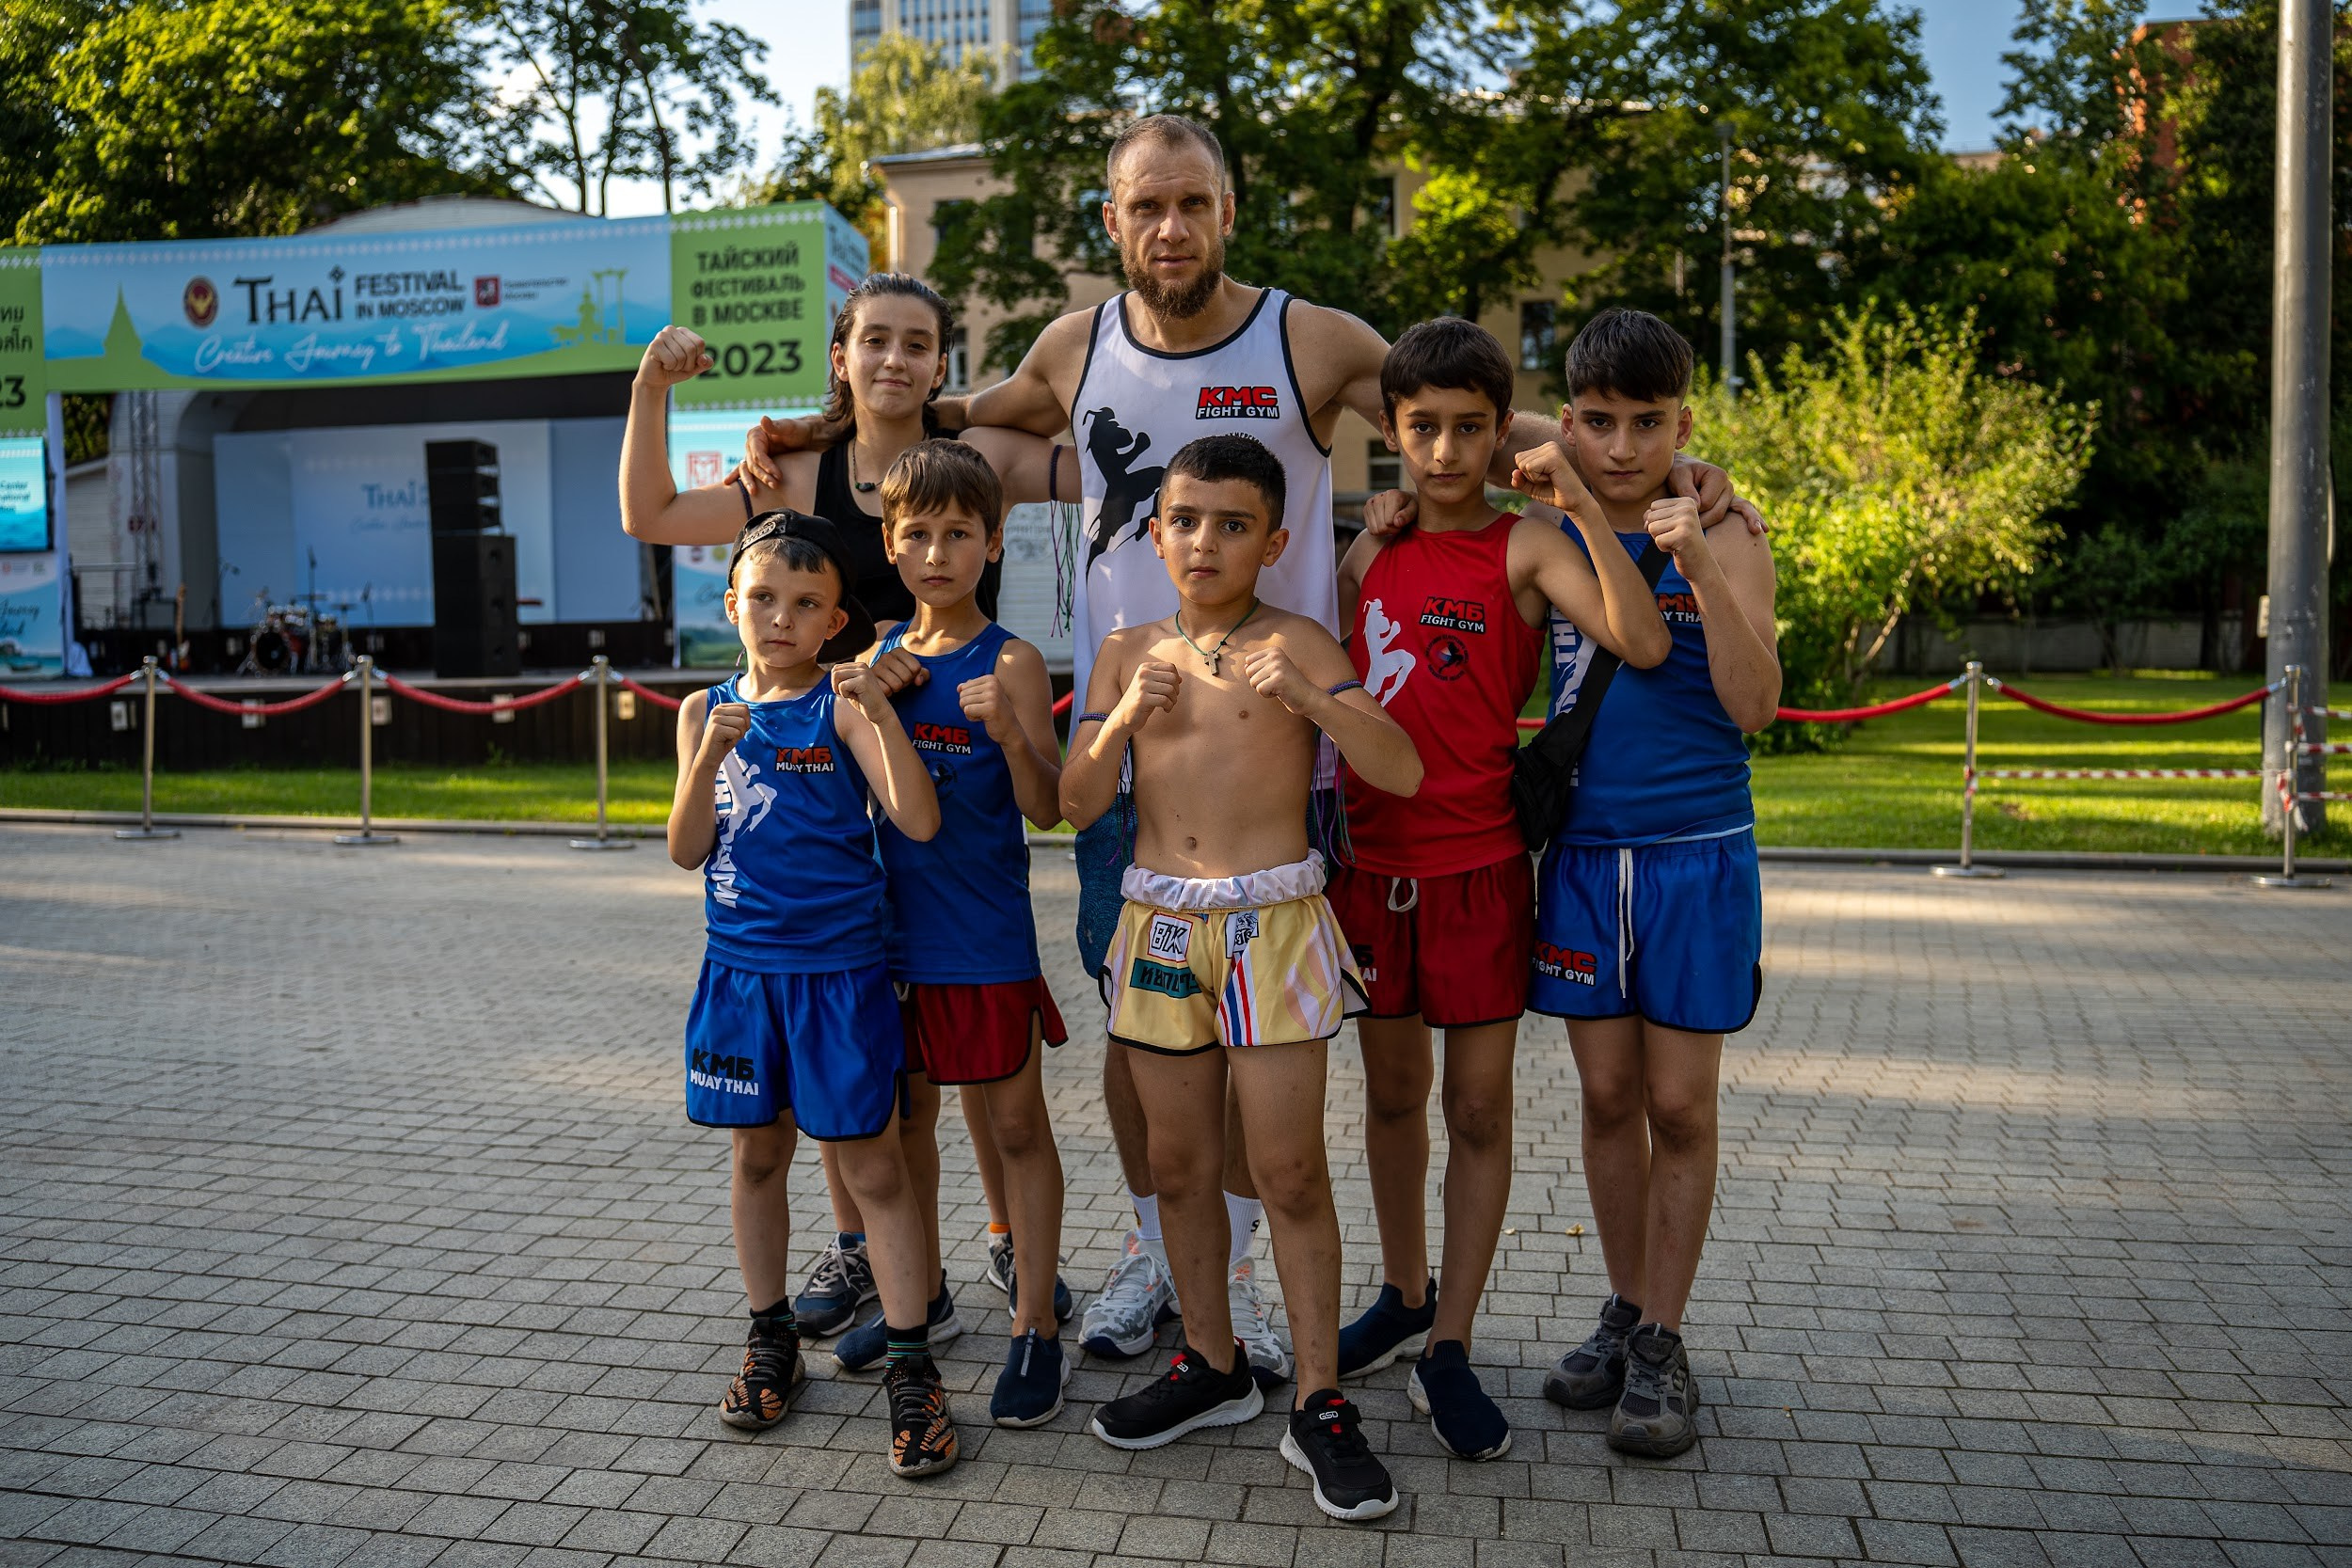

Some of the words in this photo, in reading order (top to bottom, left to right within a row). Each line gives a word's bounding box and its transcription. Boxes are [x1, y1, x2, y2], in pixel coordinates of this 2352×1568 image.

[696, 241, 800, 273] ТАЙСКИЙ
[355, 269, 467, 296] FESTIVAL
[691, 273, 805, 298] ФЕСТИВАЛЬ
[356, 301, 373, 319] IN
[378, 296, 466, 318] MOSCOW
[692, 305, 707, 326] В
[713, 297, 804, 325] МОСКВЕ
[411, 320, 510, 361] Thailand
[1197, 406, 1242, 419] FIGHT
[1246, 405, 1279, 418] GYM
[1421, 614, 1455, 627] FIGHT
[1457, 620, 1484, 633] GYM
[913, 739, 944, 751] FIGHT
[946, 743, 971, 754] GYM
[804, 763, 834, 773] THAI
[1565, 969, 1595, 986] GYM
[690, 1069, 723, 1091] MUAY
[723, 1078, 759, 1096] THAI
